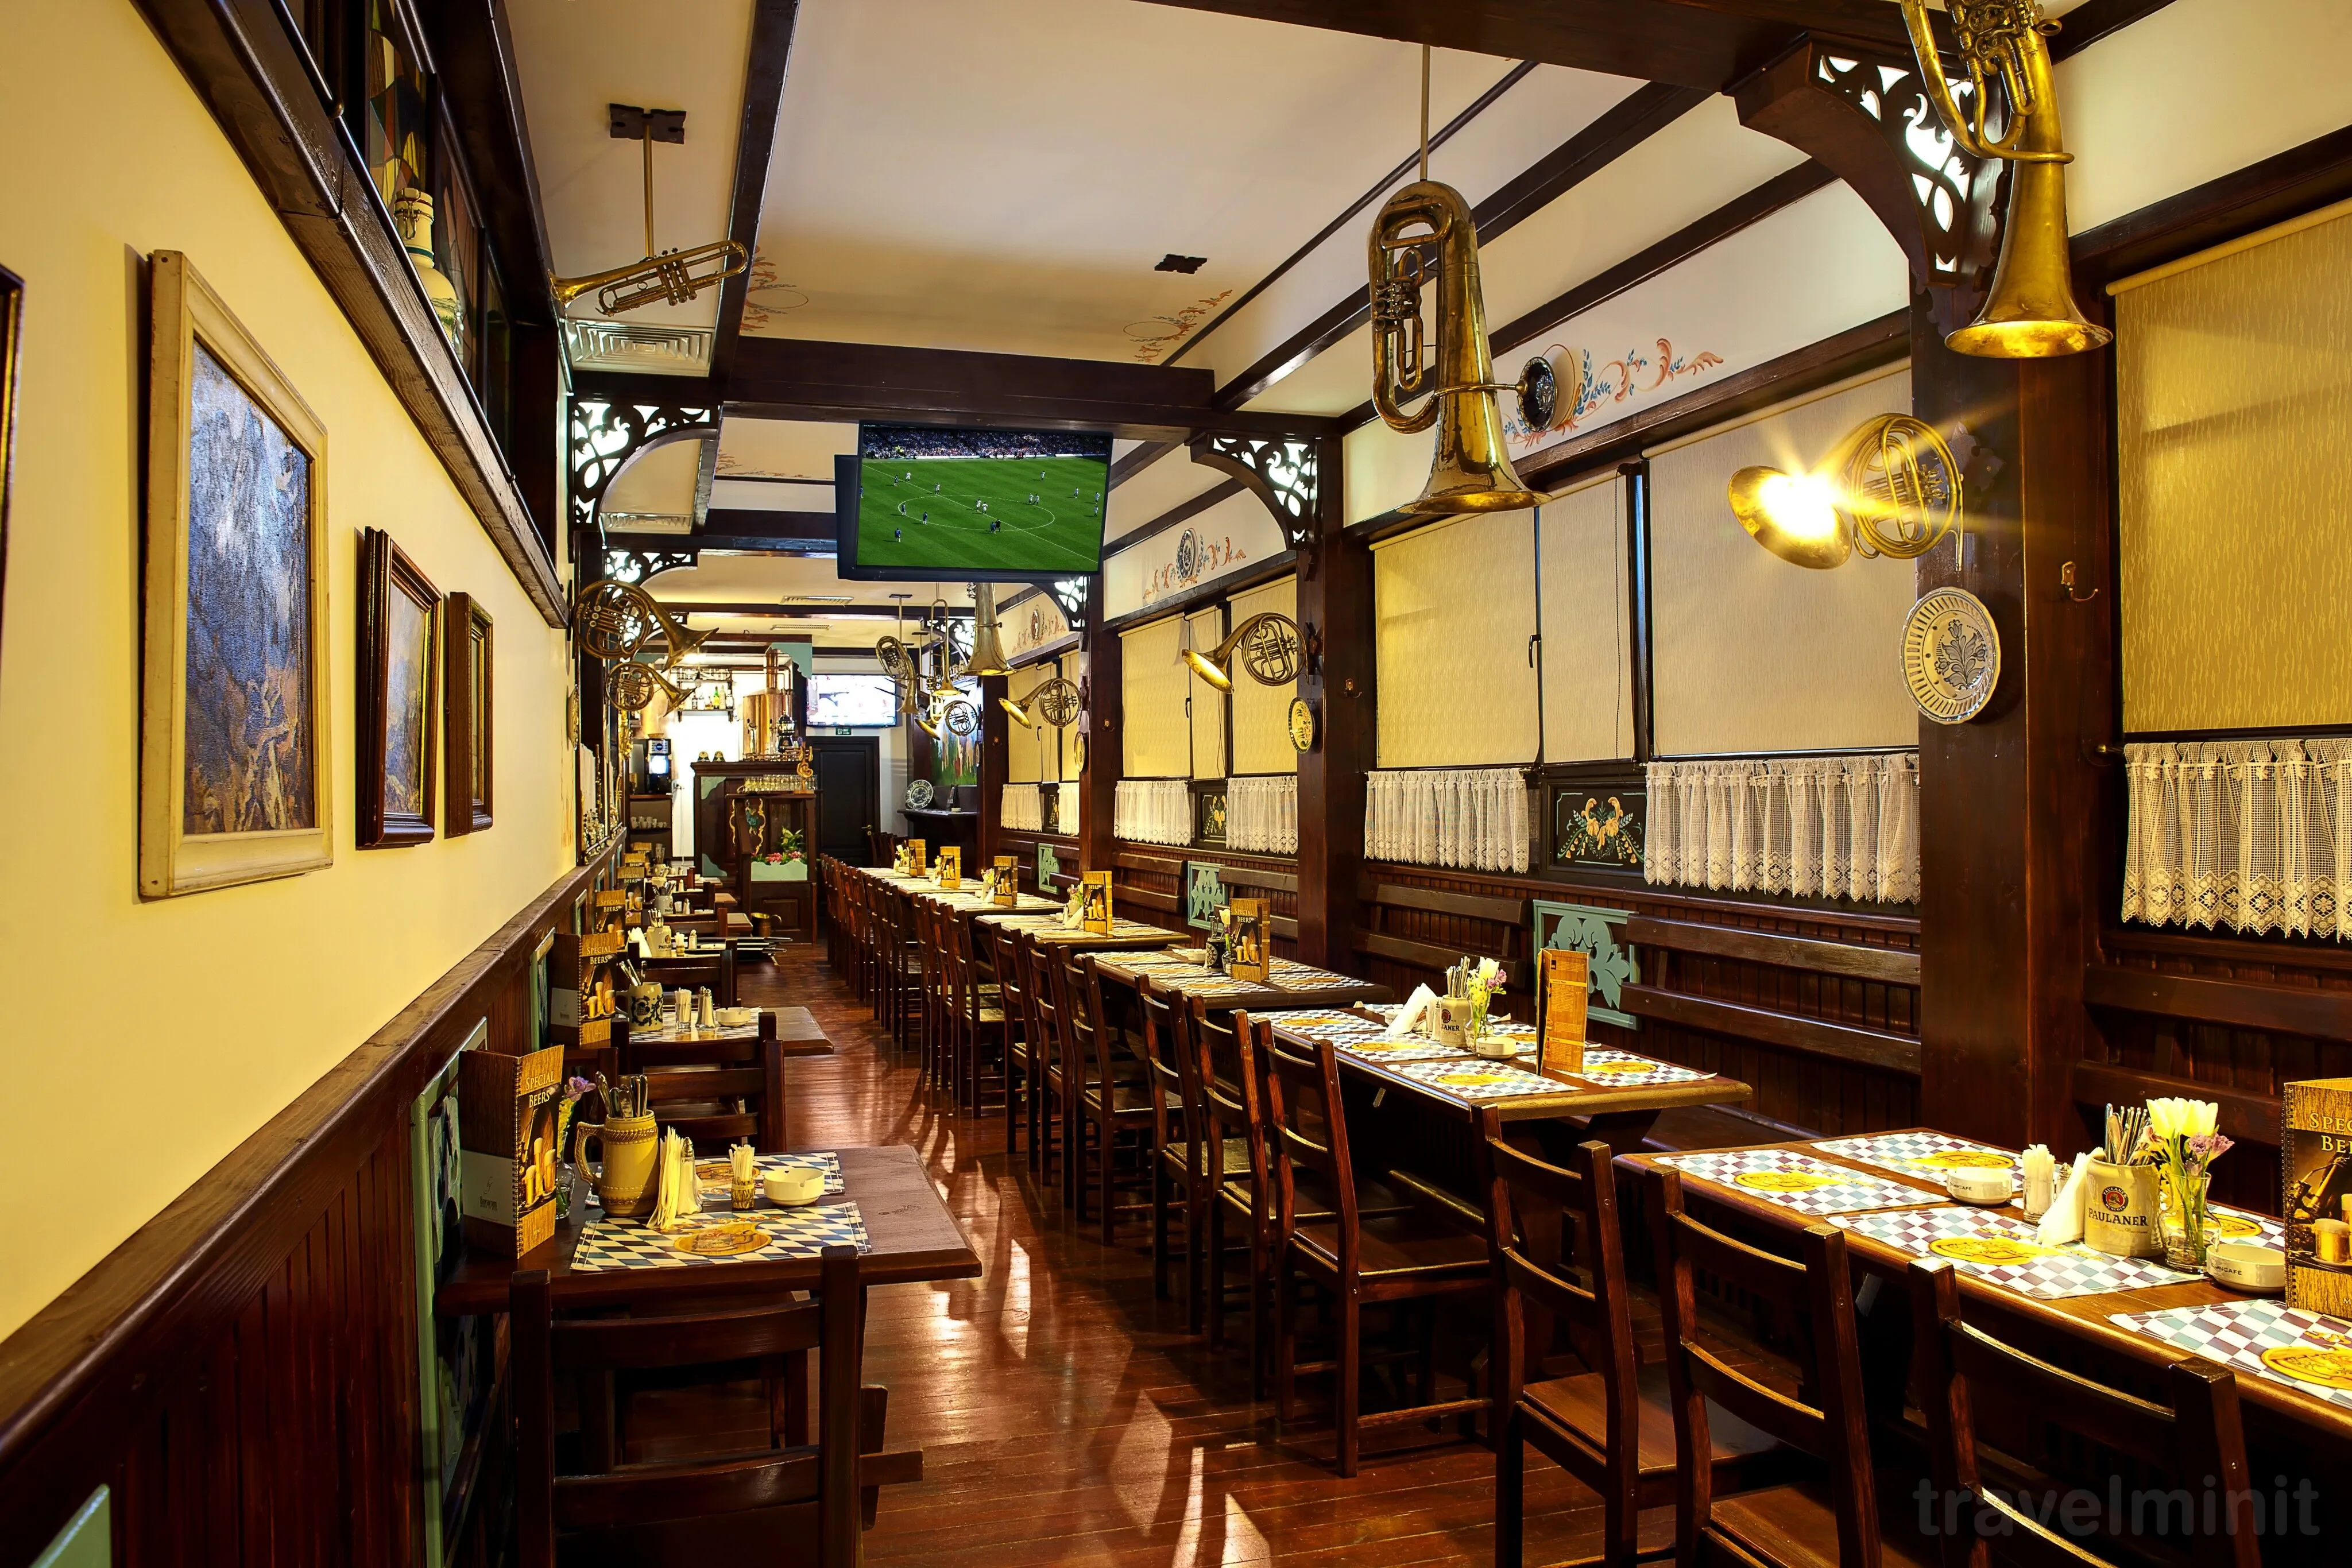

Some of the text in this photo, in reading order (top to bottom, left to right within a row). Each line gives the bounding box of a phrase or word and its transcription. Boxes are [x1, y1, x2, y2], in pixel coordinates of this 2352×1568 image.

[586, 946, 612, 955] SPECIAL
[590, 955, 608, 965] BEERS
[525, 1071, 555, 1091] SPECIAL
[529, 1090, 550, 1109] BEERS
[2088, 1207, 2149, 1226] PAULANER
